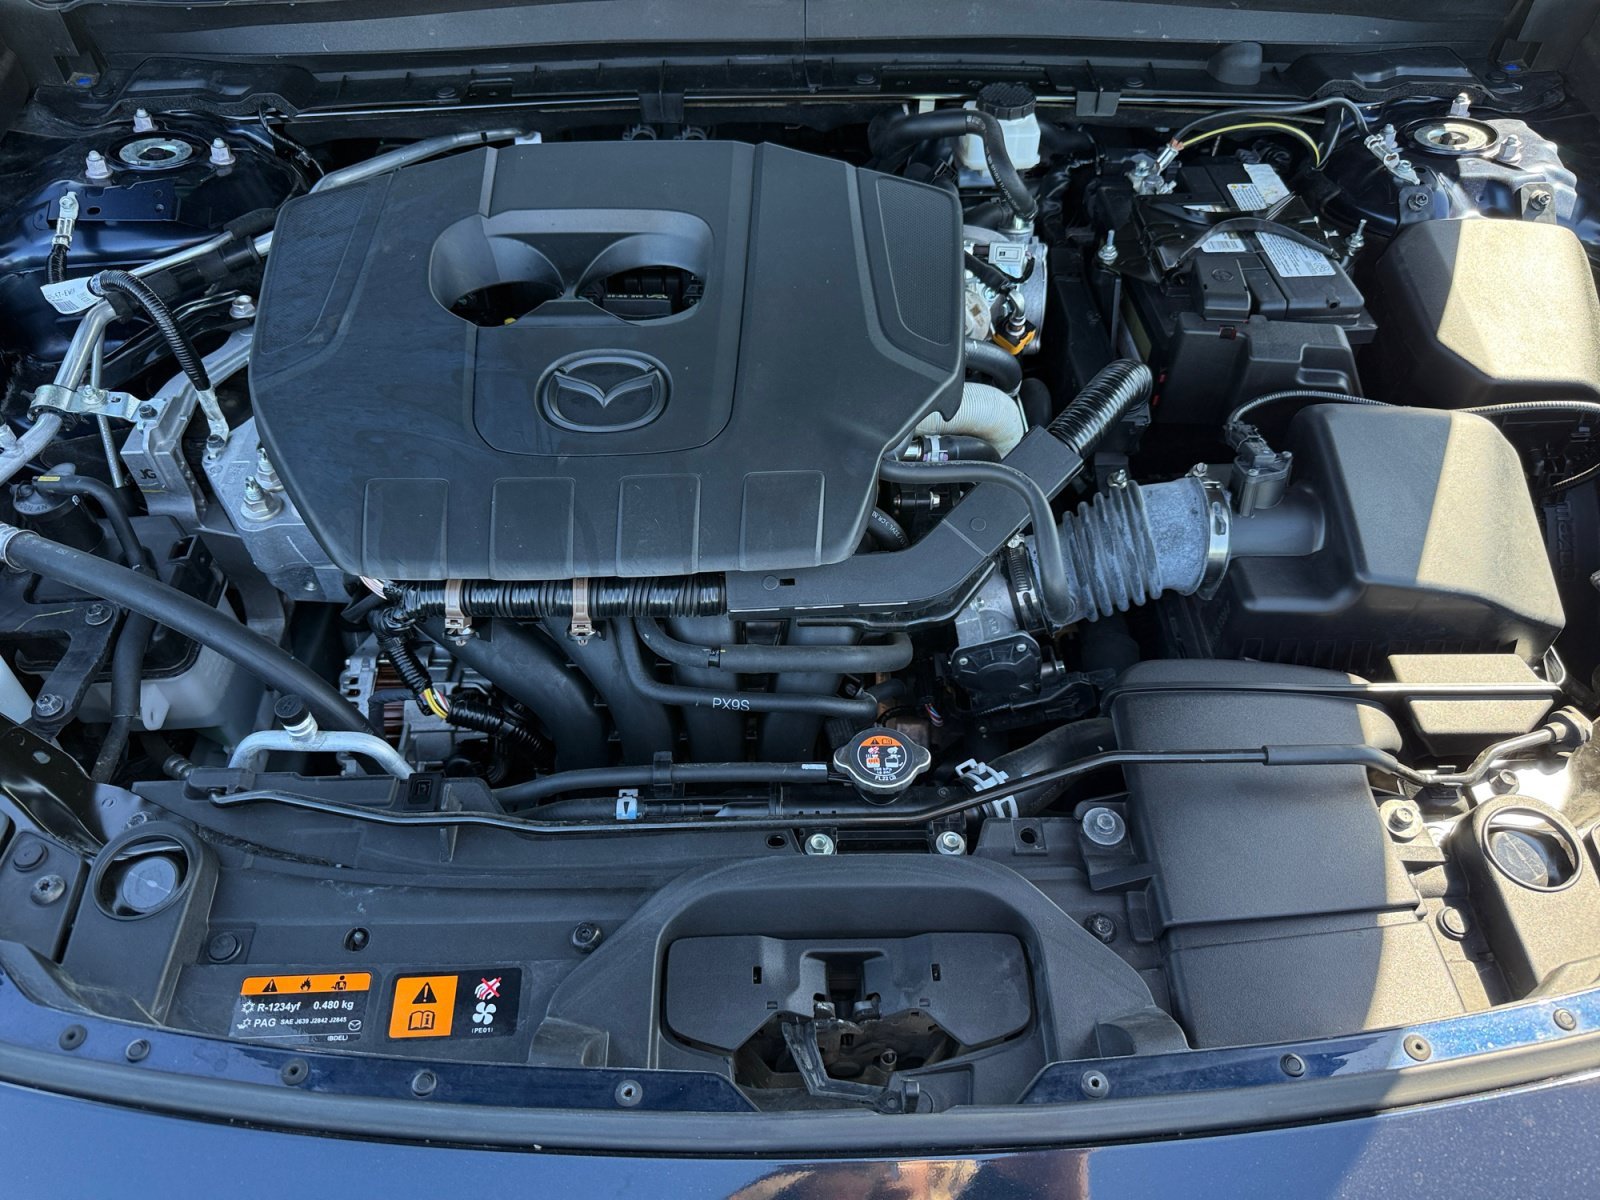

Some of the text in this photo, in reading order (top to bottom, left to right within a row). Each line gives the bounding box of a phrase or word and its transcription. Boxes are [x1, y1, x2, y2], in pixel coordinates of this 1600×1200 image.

[712, 697, 750, 711] PX9S
[257, 1000, 354, 1013] R-1234yf 0.480 kg
[253, 1018, 276, 1028] PAG
